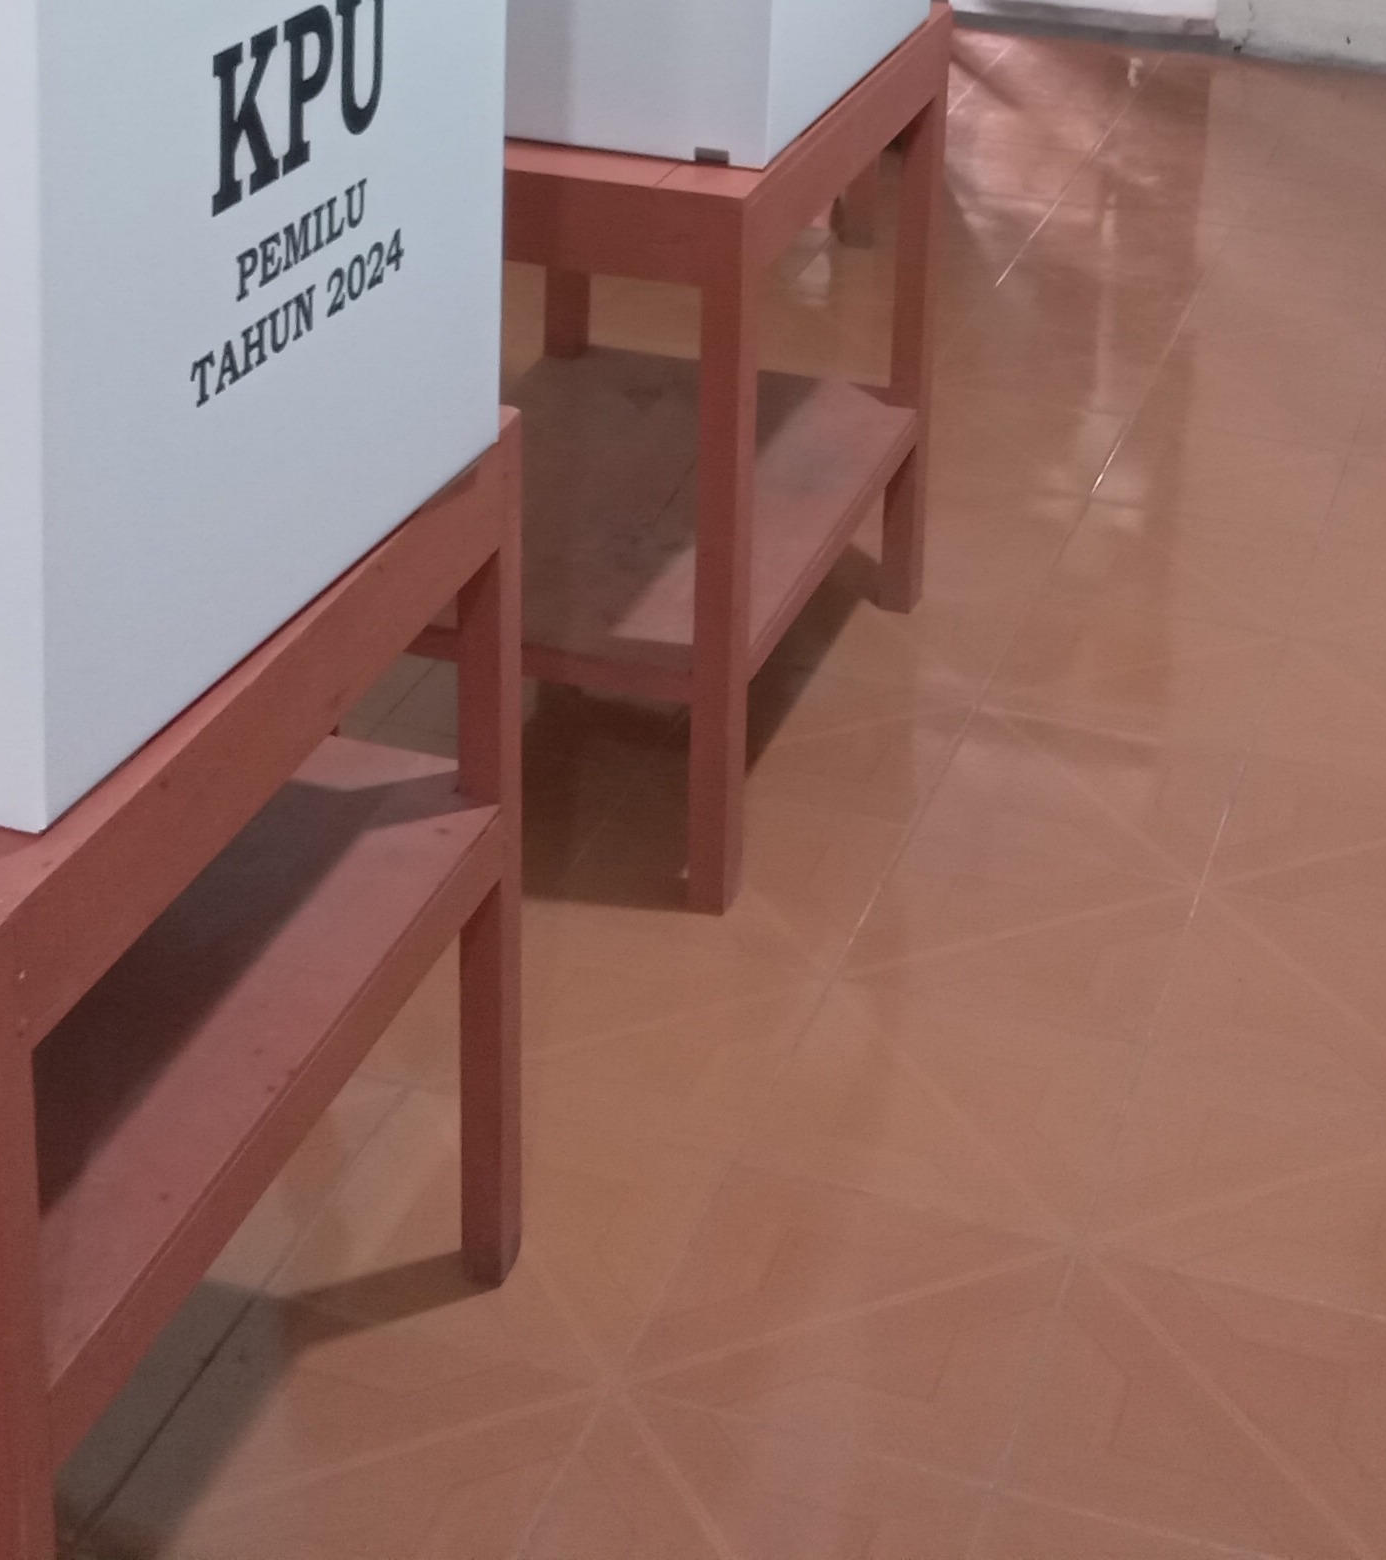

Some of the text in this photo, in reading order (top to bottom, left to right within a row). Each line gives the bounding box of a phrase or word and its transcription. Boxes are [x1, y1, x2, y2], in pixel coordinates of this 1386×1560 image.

[236, 178, 368, 302] PEMILU
[190, 230, 404, 408] TAHUN 2024
